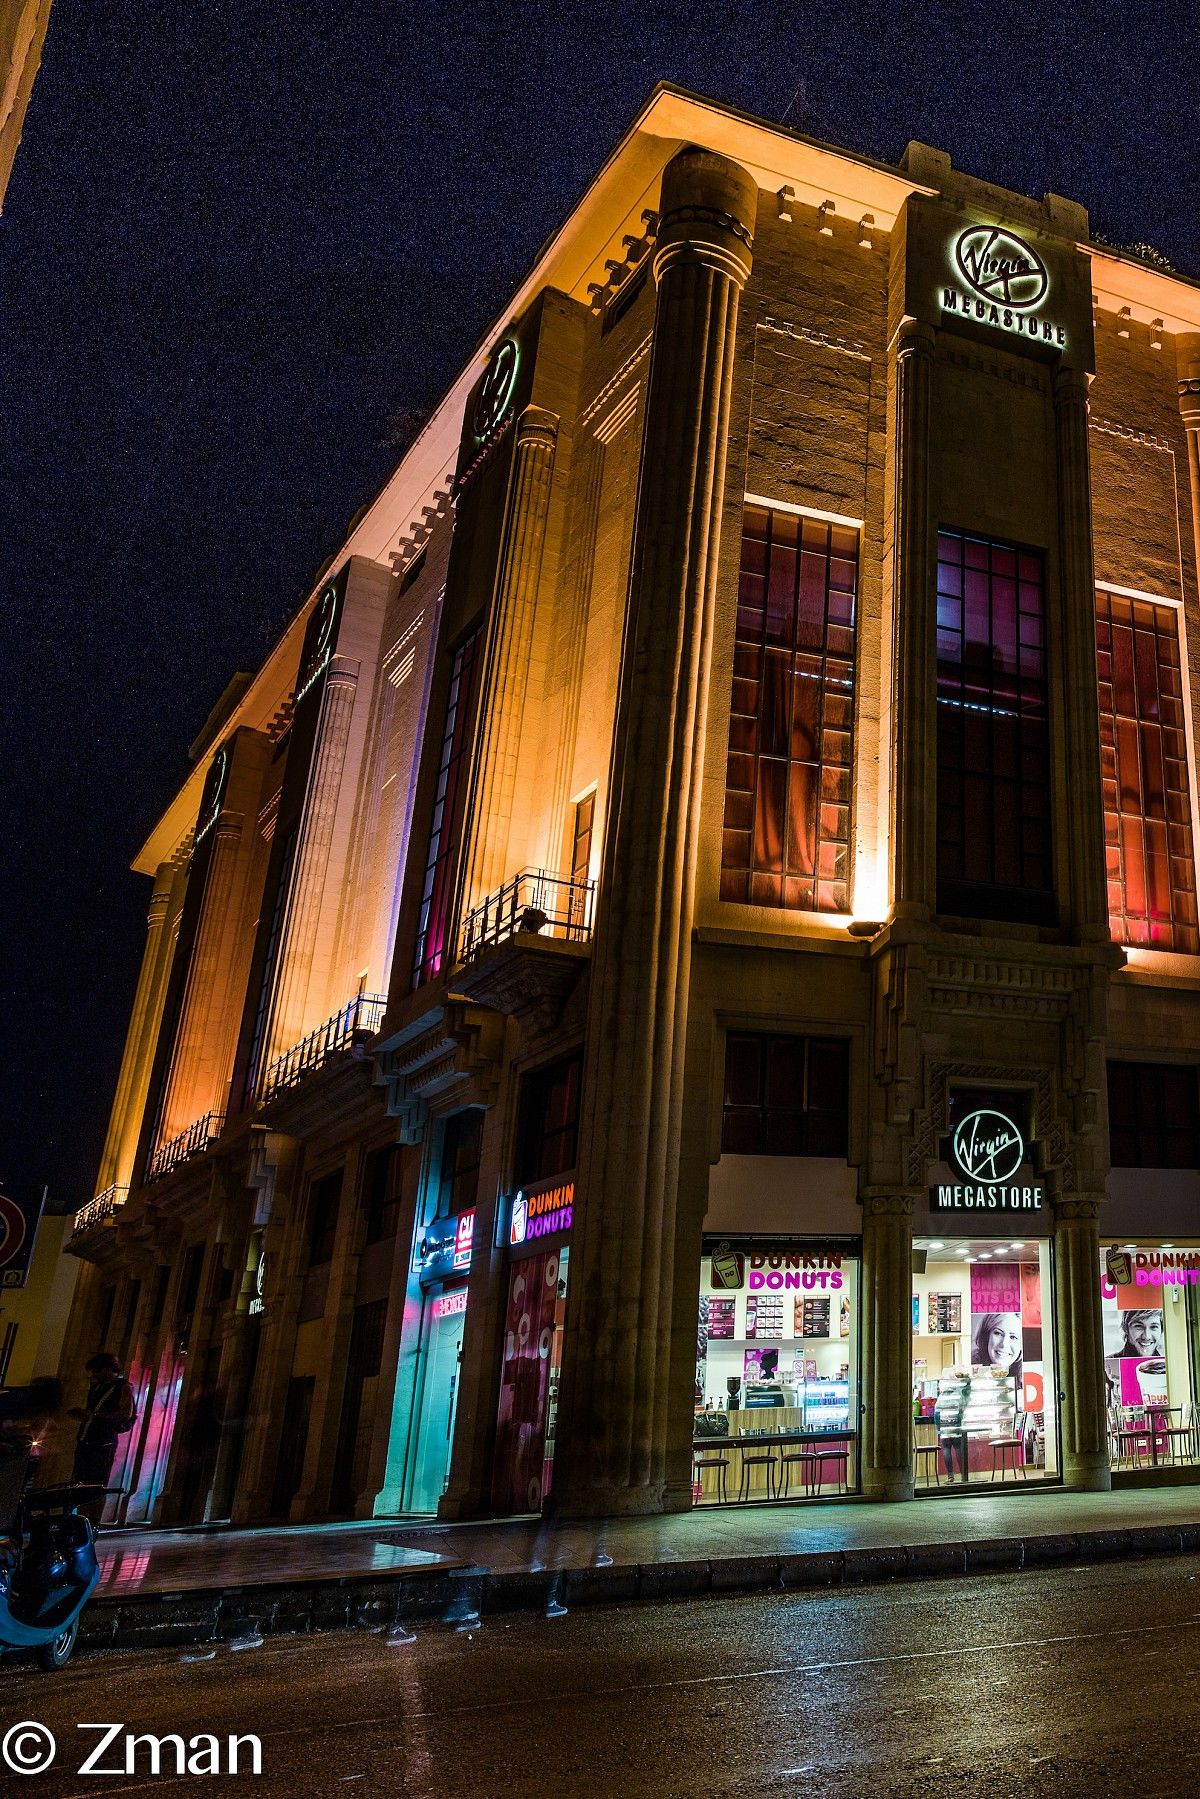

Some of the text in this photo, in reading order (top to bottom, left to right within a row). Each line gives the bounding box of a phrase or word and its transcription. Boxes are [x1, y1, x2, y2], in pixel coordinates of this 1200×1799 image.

[962, 229, 1044, 303] Virgin
[943, 288, 1065, 345] MEGASTORE
[958, 1114, 1020, 1178] Virgin
[938, 1185, 1042, 1208] MEGASTORE
[526, 1206, 573, 1240] DONUTS
[749, 1271, 843, 1290] DONUTS
